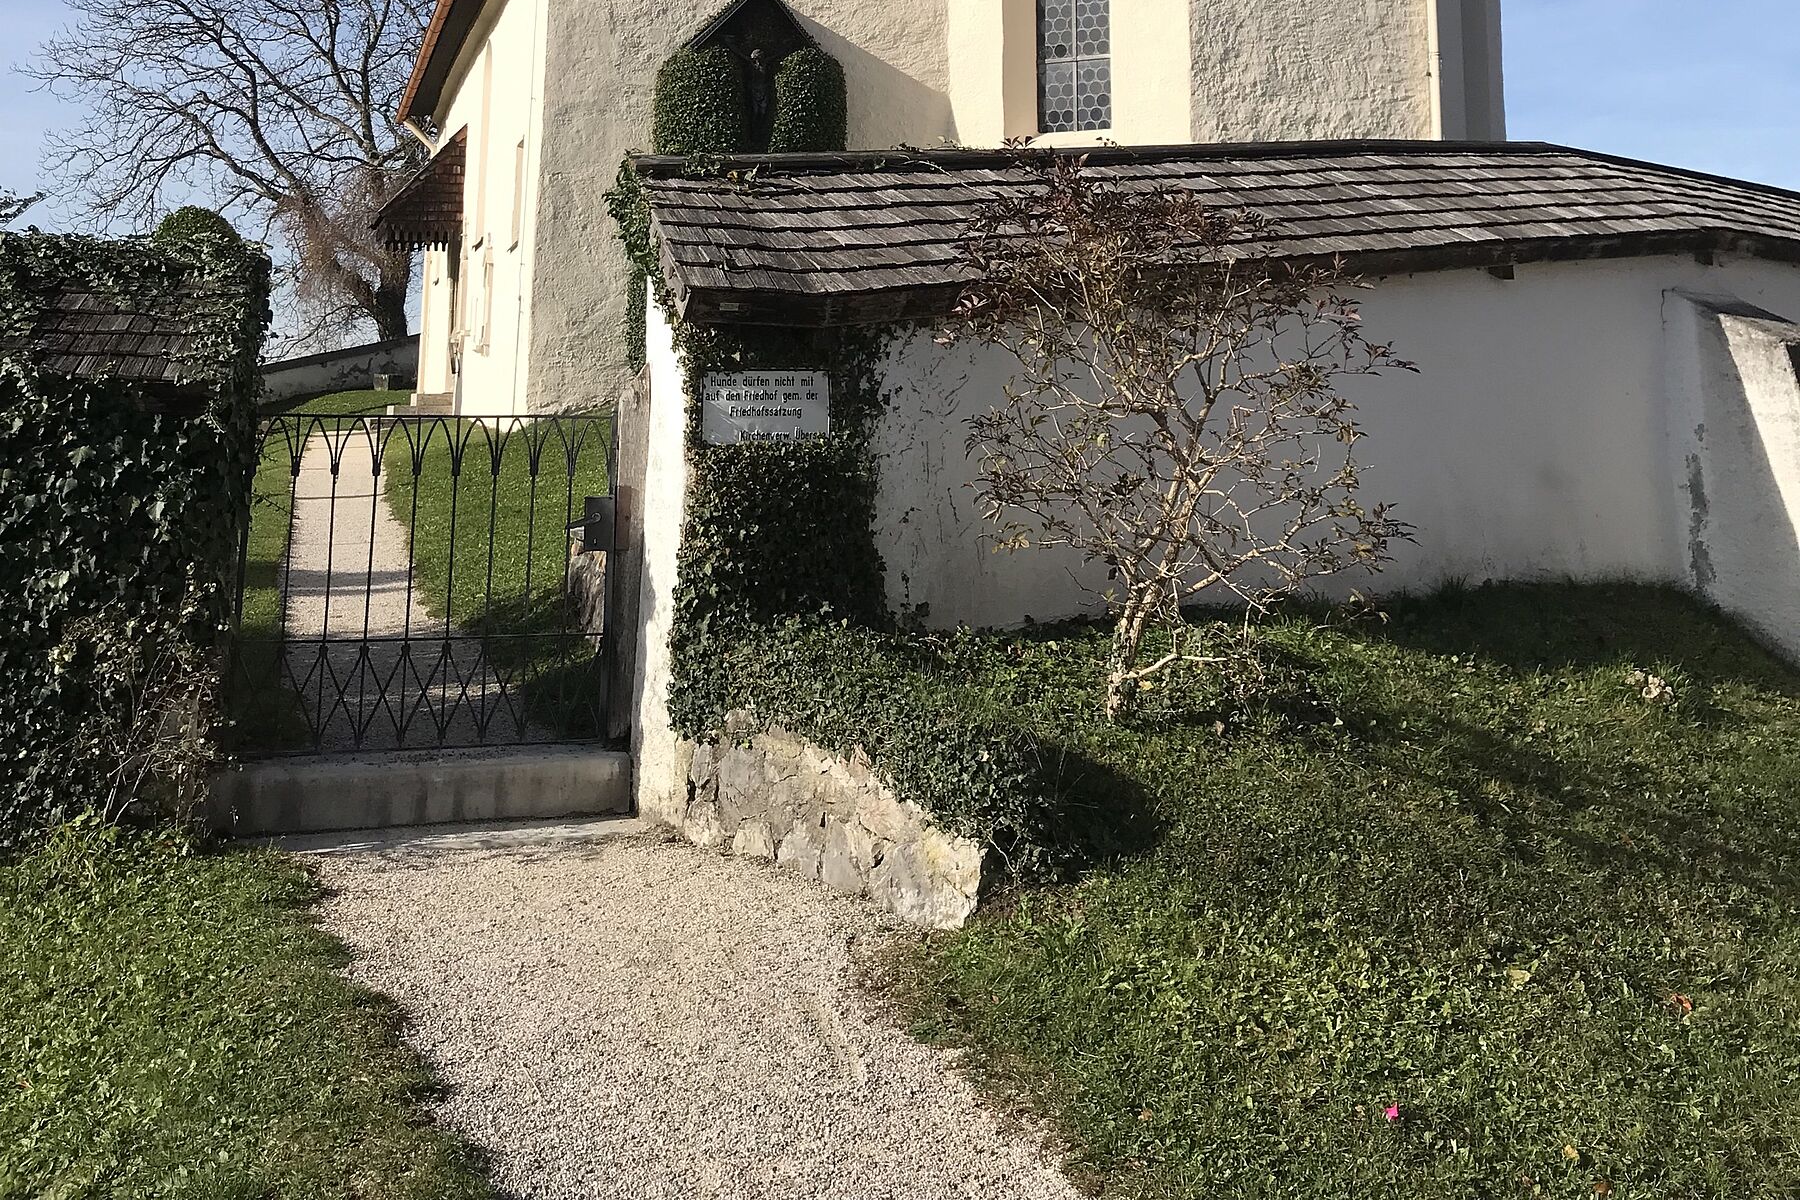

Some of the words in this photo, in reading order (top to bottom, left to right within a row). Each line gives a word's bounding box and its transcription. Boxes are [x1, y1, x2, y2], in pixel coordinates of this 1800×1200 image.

[710, 376, 737, 386] Hunde
[742, 376, 770, 387] dürfen
[775, 376, 795, 387] nicht
[801, 376, 815, 387] mit
[705, 390, 720, 401] auf
[725, 390, 740, 401] den
[743, 390, 778, 401] Friedhof
[782, 392, 802, 403] gem.
[806, 390, 818, 401] der
[730, 405, 802, 419] Friedhofssatzung
[740, 430, 792, 441] Kirchenverw.
